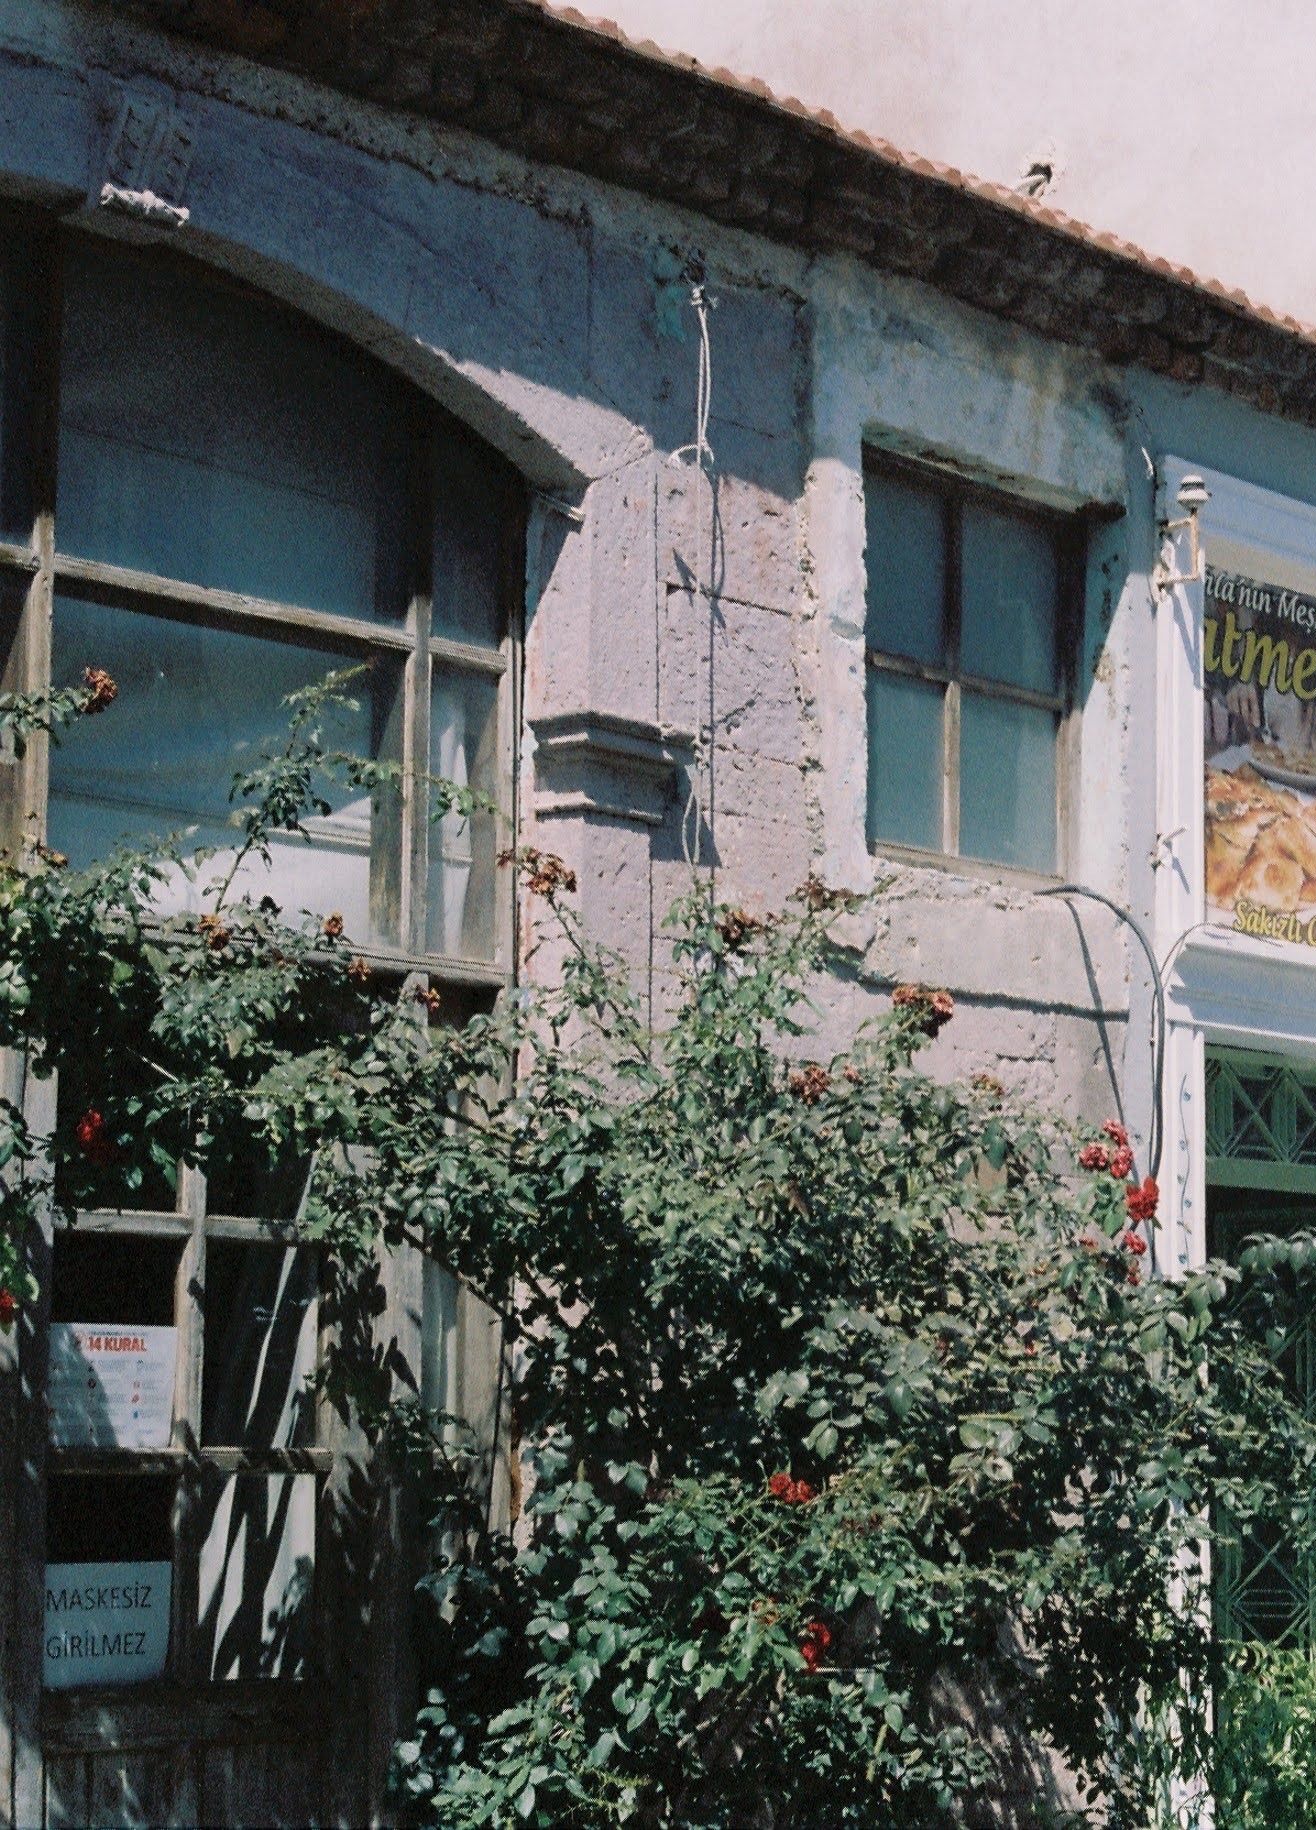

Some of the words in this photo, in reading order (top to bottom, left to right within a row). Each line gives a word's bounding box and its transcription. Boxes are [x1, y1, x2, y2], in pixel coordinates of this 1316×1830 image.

[1204, 568, 1271, 614] rla'nın
[87, 1336, 101, 1352] 14
[103, 1336, 146, 1352] KURAL
[46, 1582, 152, 1612] MASKESİZ
[46, 1629, 146, 1659] GİRİLMEZ
